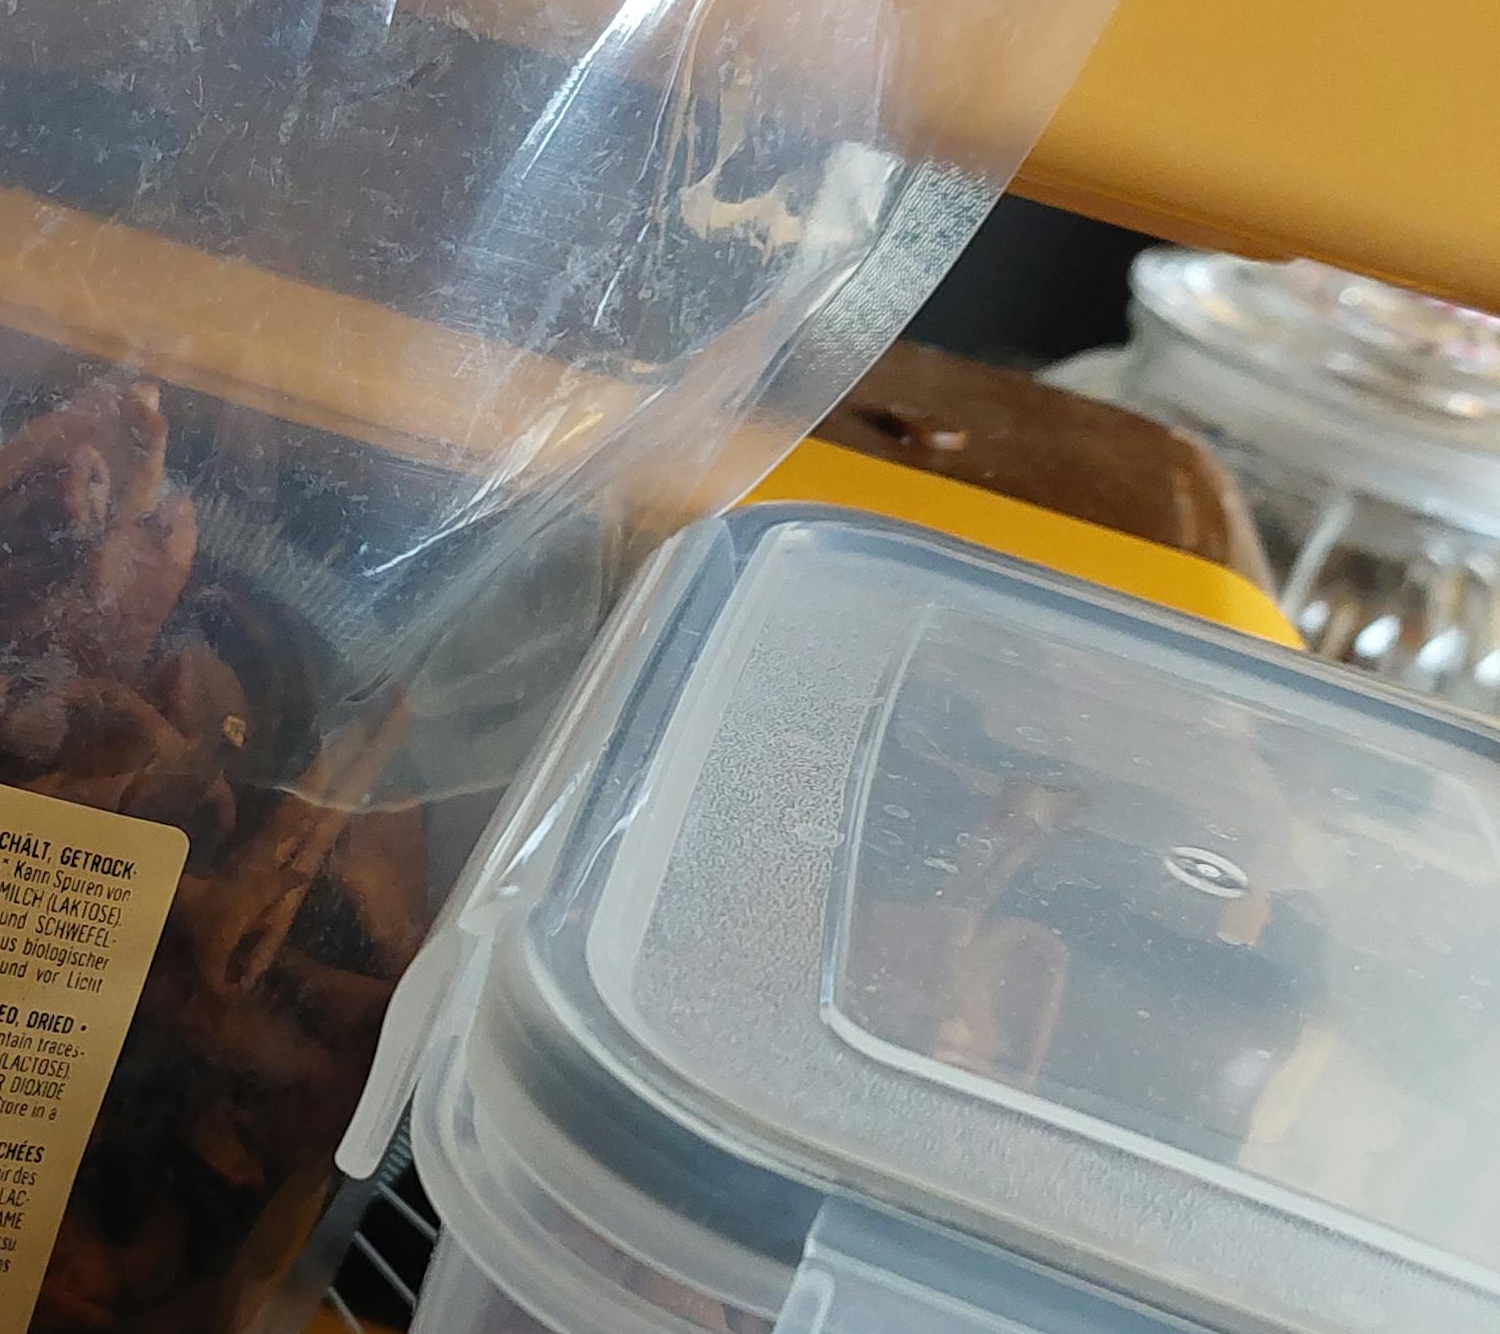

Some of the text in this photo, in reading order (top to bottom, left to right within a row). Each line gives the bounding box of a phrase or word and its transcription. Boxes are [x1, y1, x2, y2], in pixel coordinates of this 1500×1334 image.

[20, 936, 111, 975] biologischer
[34, 967, 60, 985] vor
[25, 1009, 75, 1034] DRIED
[12, 1165, 40, 1185] des
